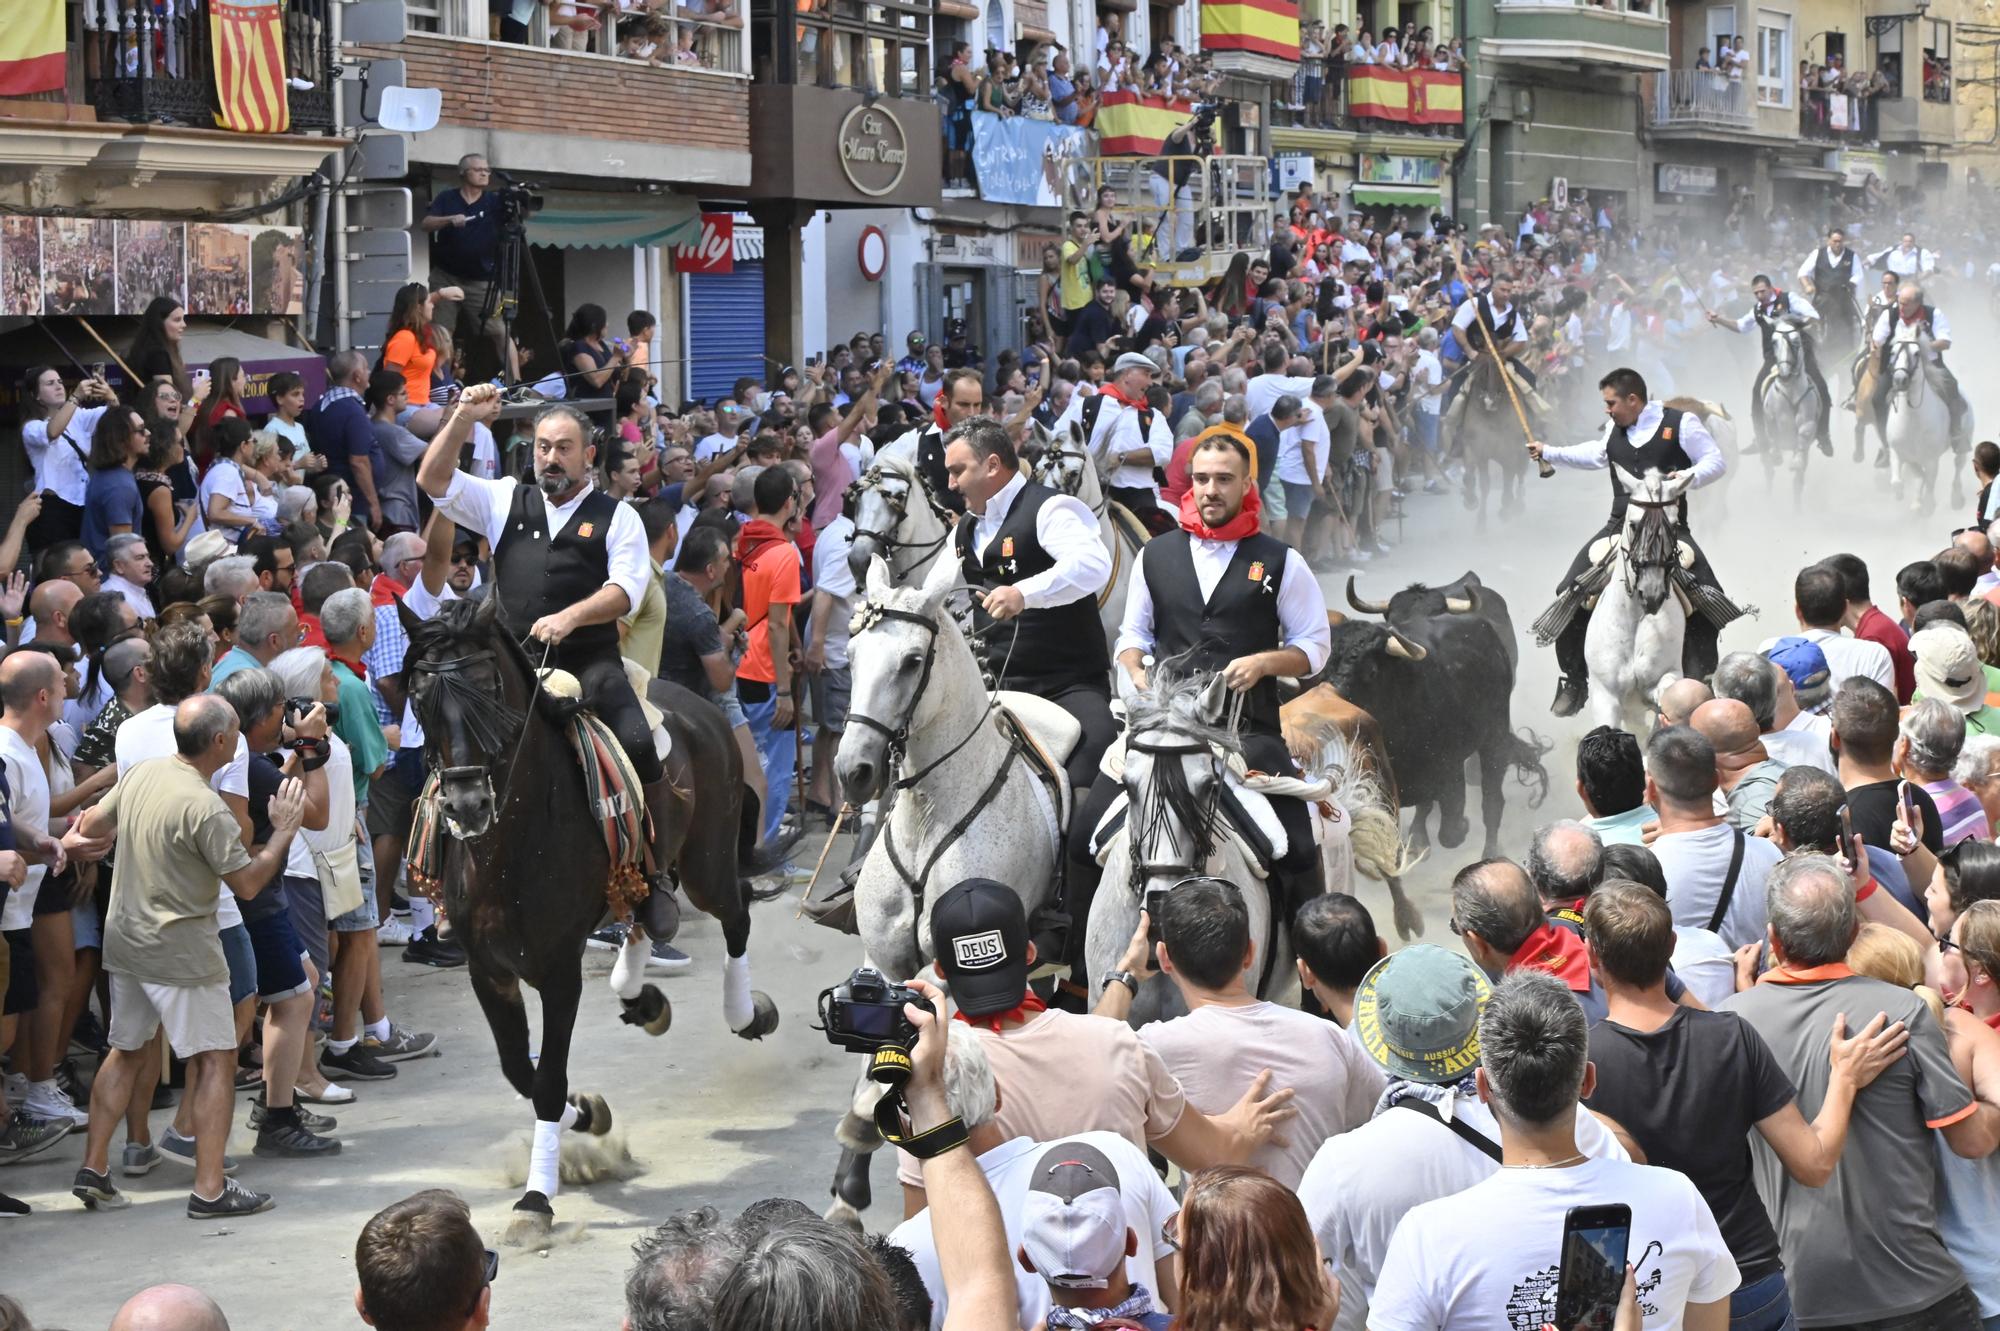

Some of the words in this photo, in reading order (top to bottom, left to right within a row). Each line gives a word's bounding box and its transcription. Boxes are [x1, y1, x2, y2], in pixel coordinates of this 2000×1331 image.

[962, 939, 997, 959] DEUS
[875, 1050, 911, 1067] Nikon
[1424, 1046, 1457, 1061] AUSSIE
